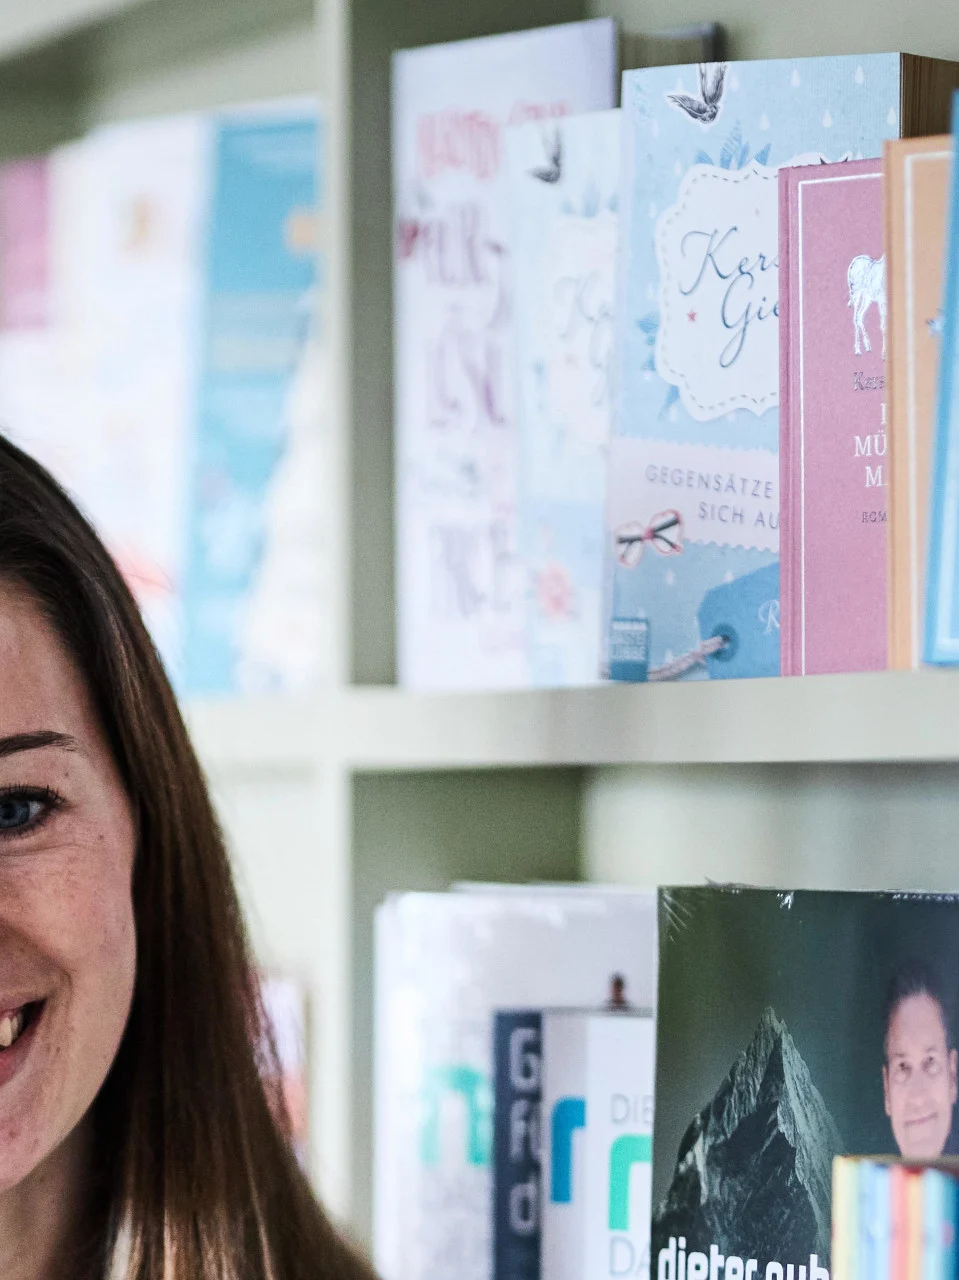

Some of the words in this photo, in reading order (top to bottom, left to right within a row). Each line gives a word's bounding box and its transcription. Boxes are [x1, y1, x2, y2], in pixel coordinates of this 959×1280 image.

[645, 463, 774, 499] GEGENSÄTZE
[865, 465, 888, 488] M
[698, 501, 745, 525] SICH
